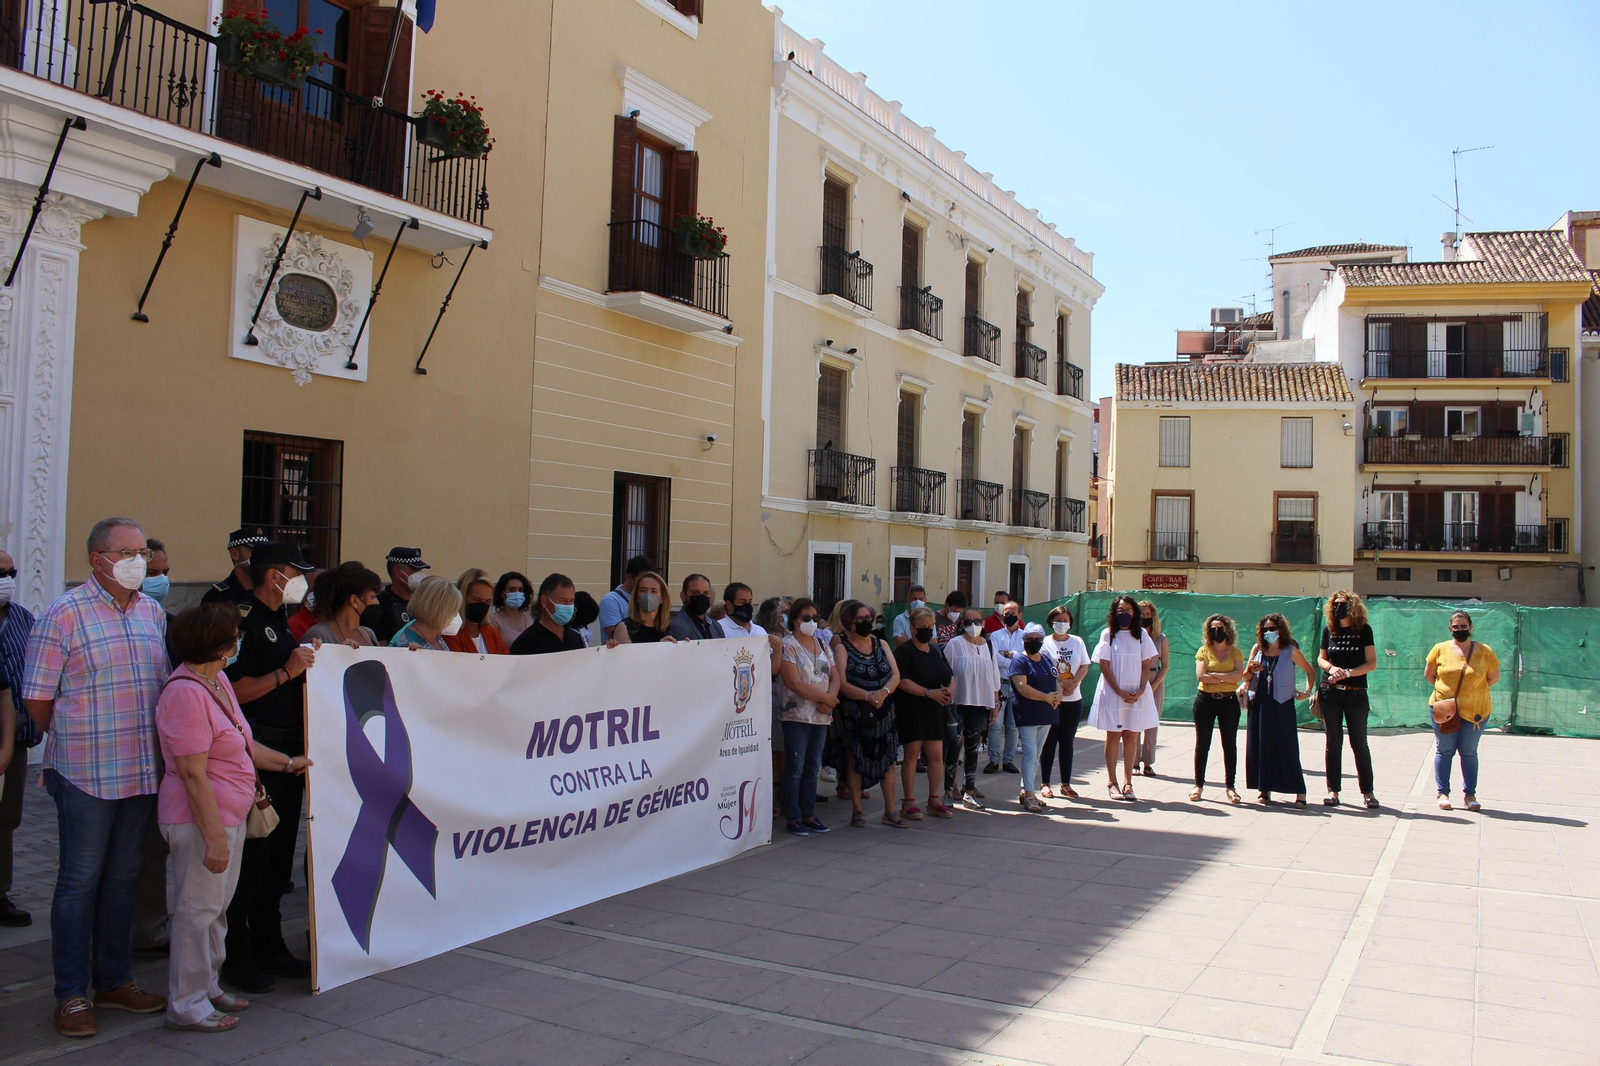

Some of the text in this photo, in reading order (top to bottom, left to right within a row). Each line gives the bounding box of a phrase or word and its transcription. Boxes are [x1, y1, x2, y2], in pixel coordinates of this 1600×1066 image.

[526, 705, 660, 759] MOTRIL
[722, 718, 757, 741] MOTRIL
[732, 746, 738, 755] de
[738, 743, 759, 756] Igualdad
[550, 759, 653, 796] CONTRA LA
[452, 777, 709, 860] VIOLENCIA DE GÉNERO
[717, 800, 737, 810] Mujer
